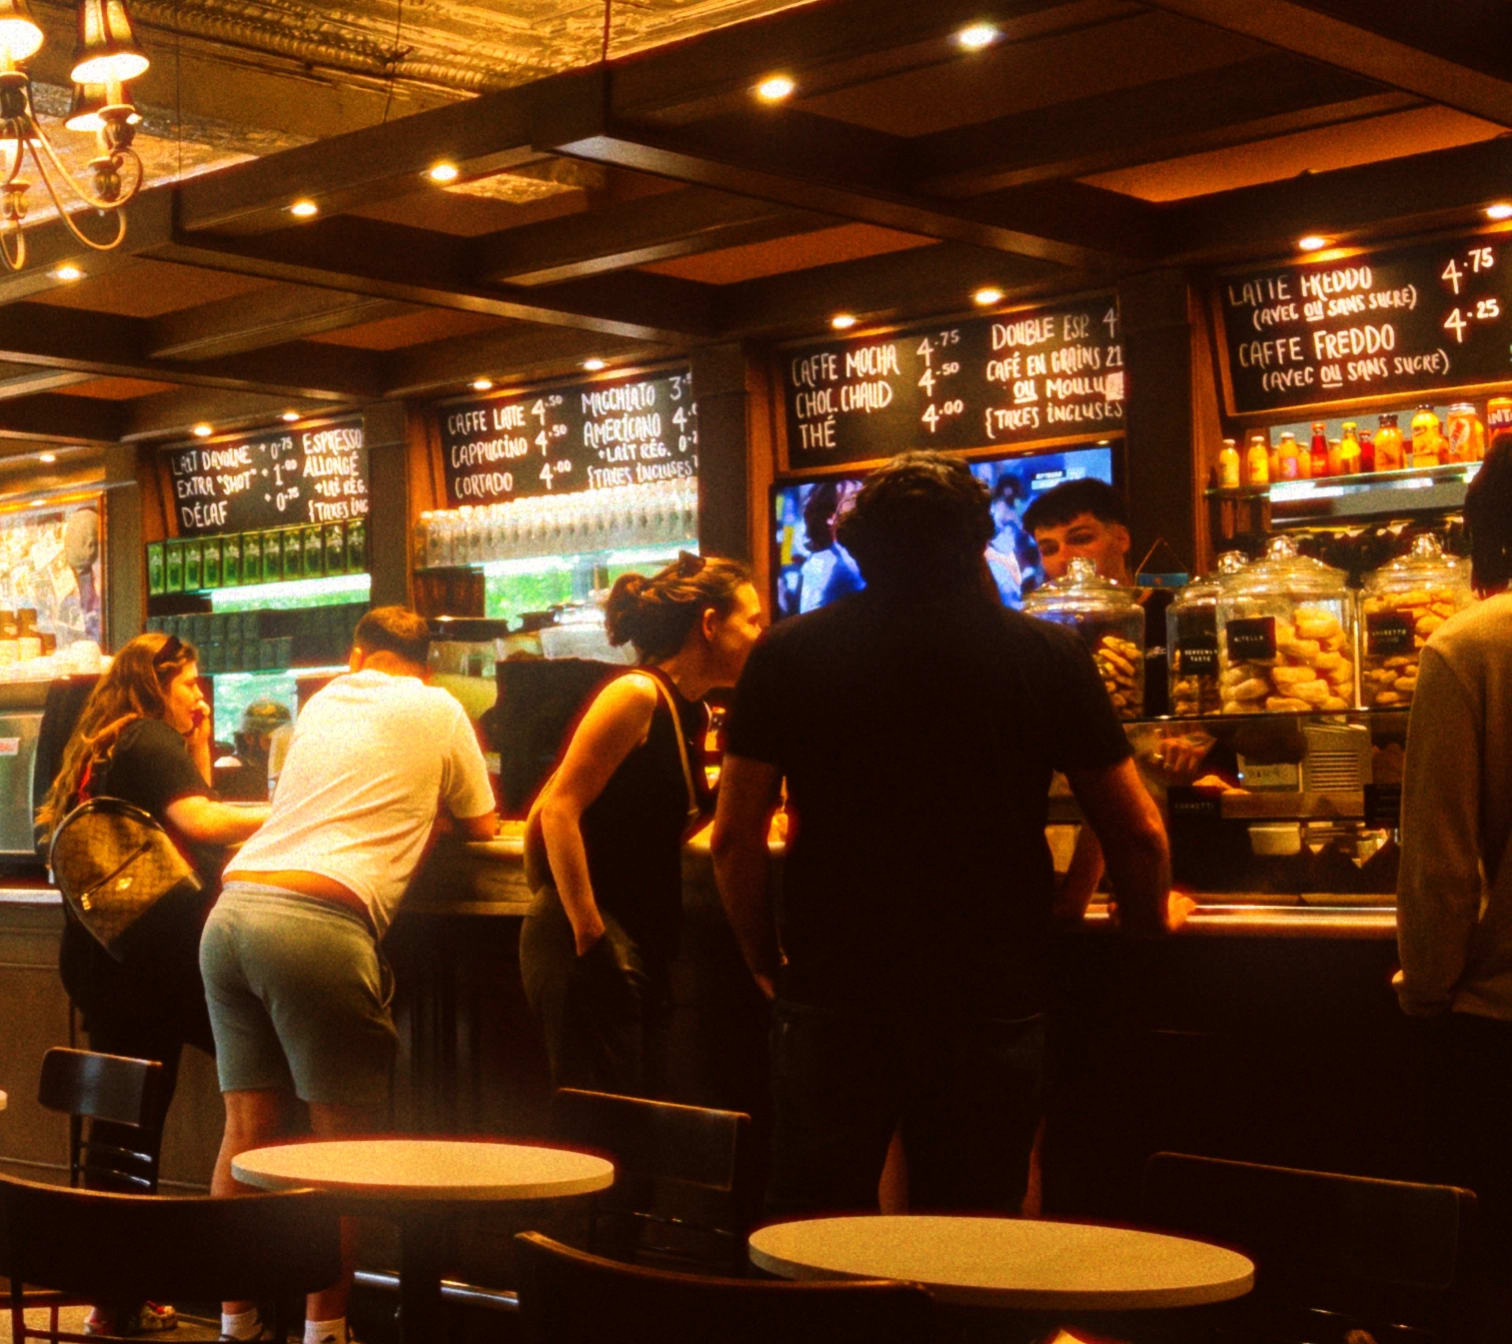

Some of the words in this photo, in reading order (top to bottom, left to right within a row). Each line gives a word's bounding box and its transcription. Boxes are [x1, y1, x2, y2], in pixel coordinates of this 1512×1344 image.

[1228, 275, 1291, 306] LATTE
[1300, 265, 1373, 301] FREDDO
[1304, 301, 1325, 322] OU
[1327, 294, 1366, 317] SANS
[992, 317, 1055, 350] DOUBLE
[1239, 336, 1304, 368] CAFFE
[1313, 324, 1395, 361] FREDDO
[792, 354, 837, 387] CAFFE
[846, 344, 900, 378] MOCHA
[986, 352, 1021, 381] CAFÉ
[1027, 355, 1047, 376] EN
[1051, 344, 1100, 375] GRAINS
[1321, 366, 1343, 388] OU
[1347, 357, 1389, 383] SANS
[581, 382, 656, 416] MACCHIATO
[841, 381, 893, 413] CHAUD
[1013, 380, 1038, 403] OU
[449, 410, 487, 435] CAFFE
[493, 405, 526, 431] LATTE
[584, 413, 661, 448] AMERICANO
[799, 417, 836, 449] THÉ
[302, 428, 363, 456] ESPRESSO
[451, 435, 528, 468] CAPPUCCINO
[302, 450, 359, 477] ALLONGÉ
[177, 475, 215, 498] EXTRA
[454, 471, 513, 499] CORTADO
[181, 500, 228, 528] DÉCAF
